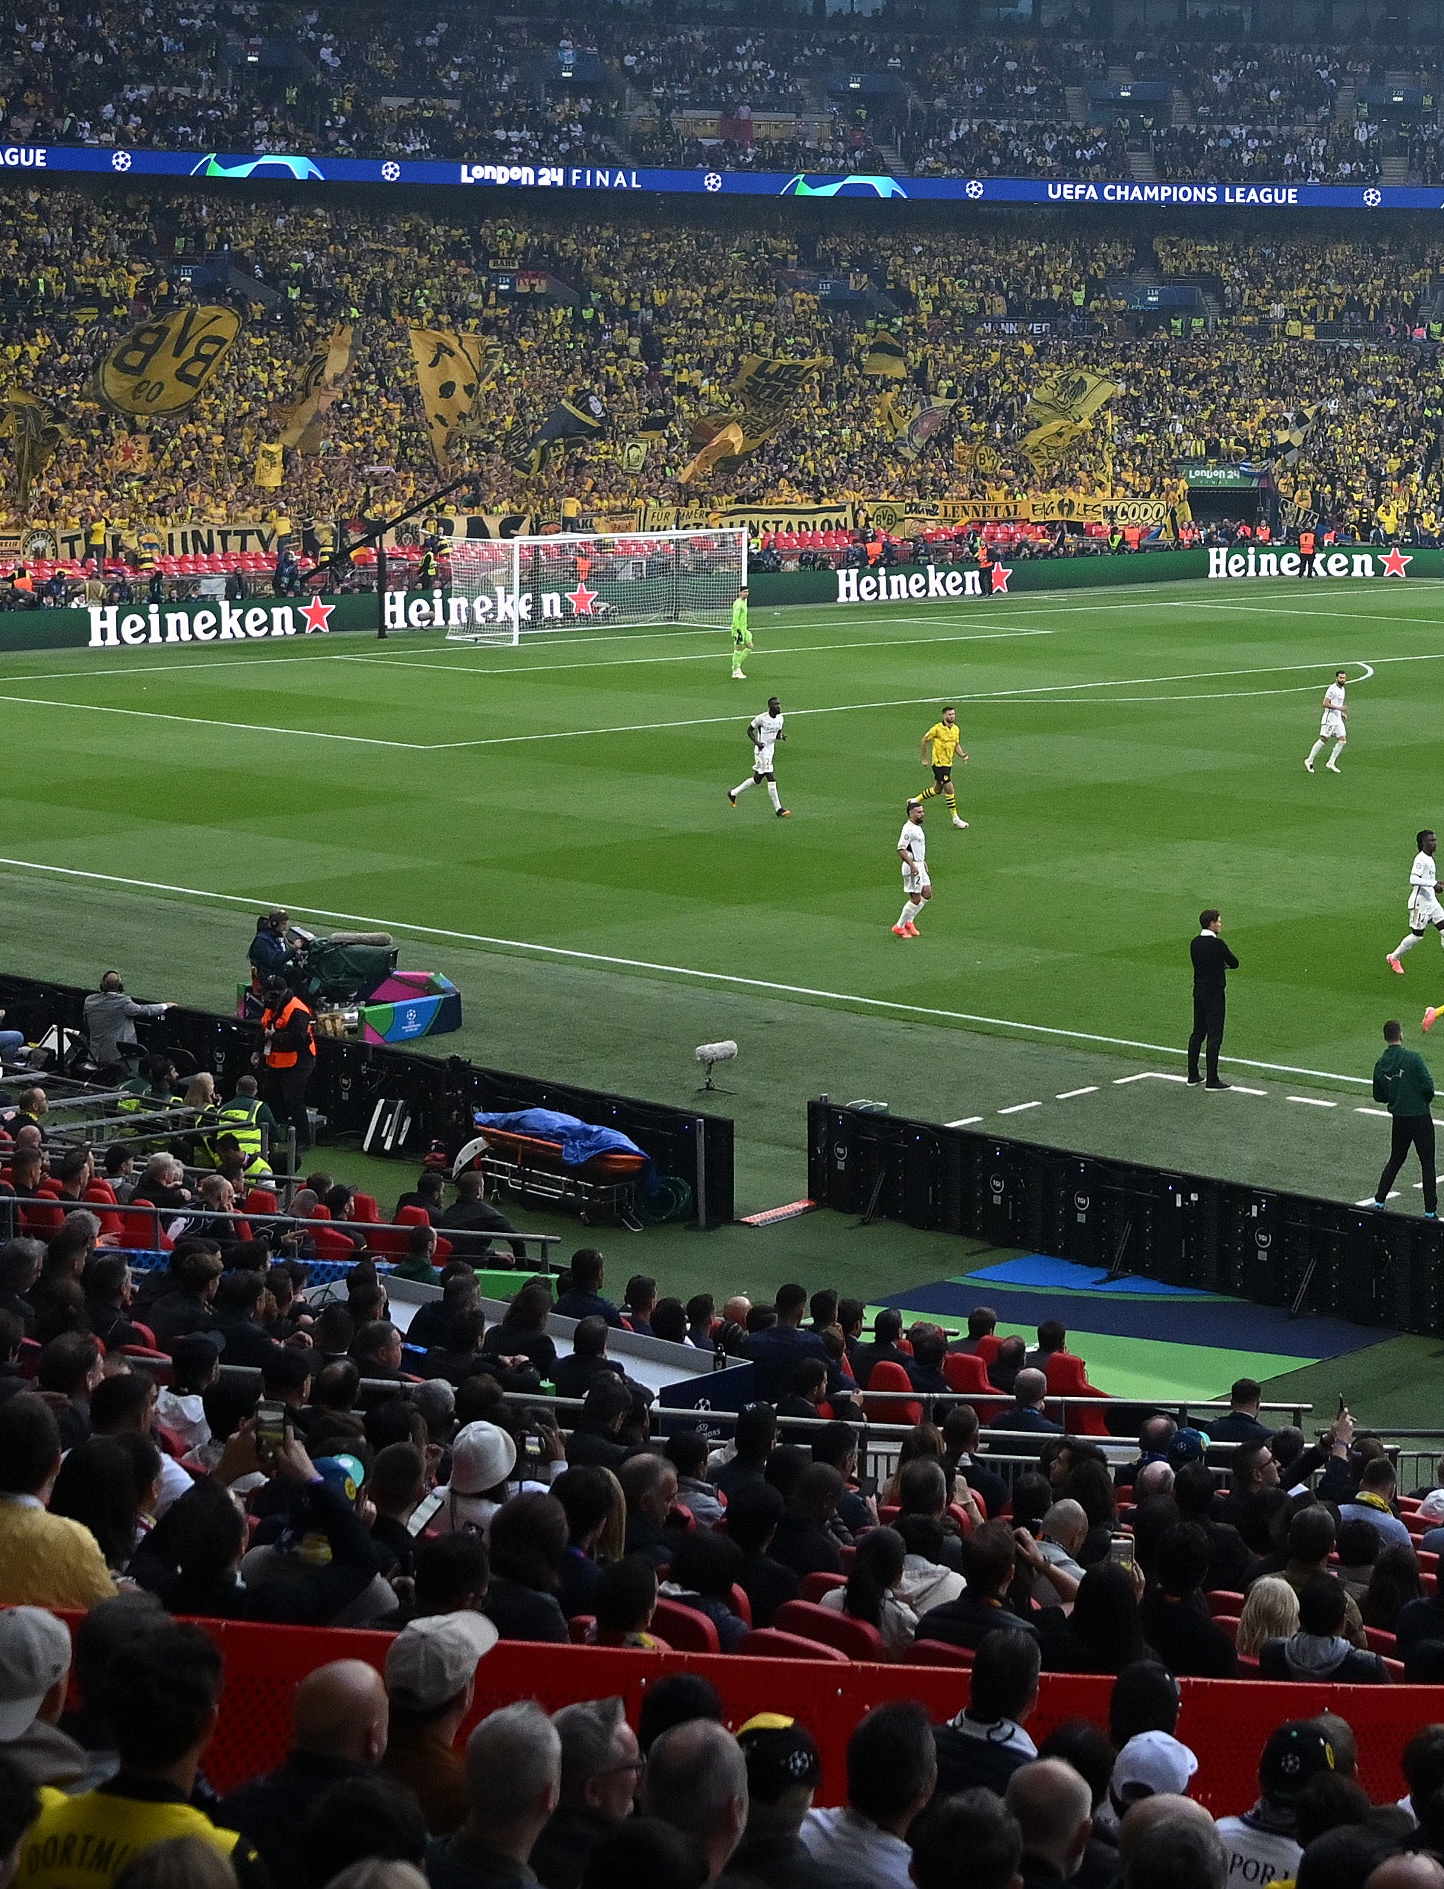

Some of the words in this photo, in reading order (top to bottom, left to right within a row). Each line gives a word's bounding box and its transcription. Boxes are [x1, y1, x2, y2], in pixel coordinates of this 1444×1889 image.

[460, 164, 534, 185] London
[538, 167, 564, 187] 24
[571, 169, 642, 188] FINAL
[1048, 183, 1099, 200] UEFA
[1104, 184, 1218, 204] CHAMPIONS
[1225, 186, 1298, 204] LEAGUE
[983, 322, 1052, 335] HNNVER
[1188, 468, 1226, 480] London
[1227, 469, 1240, 478] 24
[875, 509, 894, 526] BVB
[942, 504, 1022, 518] LENNETAL
[1117, 501, 1165, 521] CODO
[167, 528, 277, 559] UNITY
[836, 565, 982, 603] Heineken
[88, 601, 297, 647] Heineken
[916, 877, 921, 885] 2
